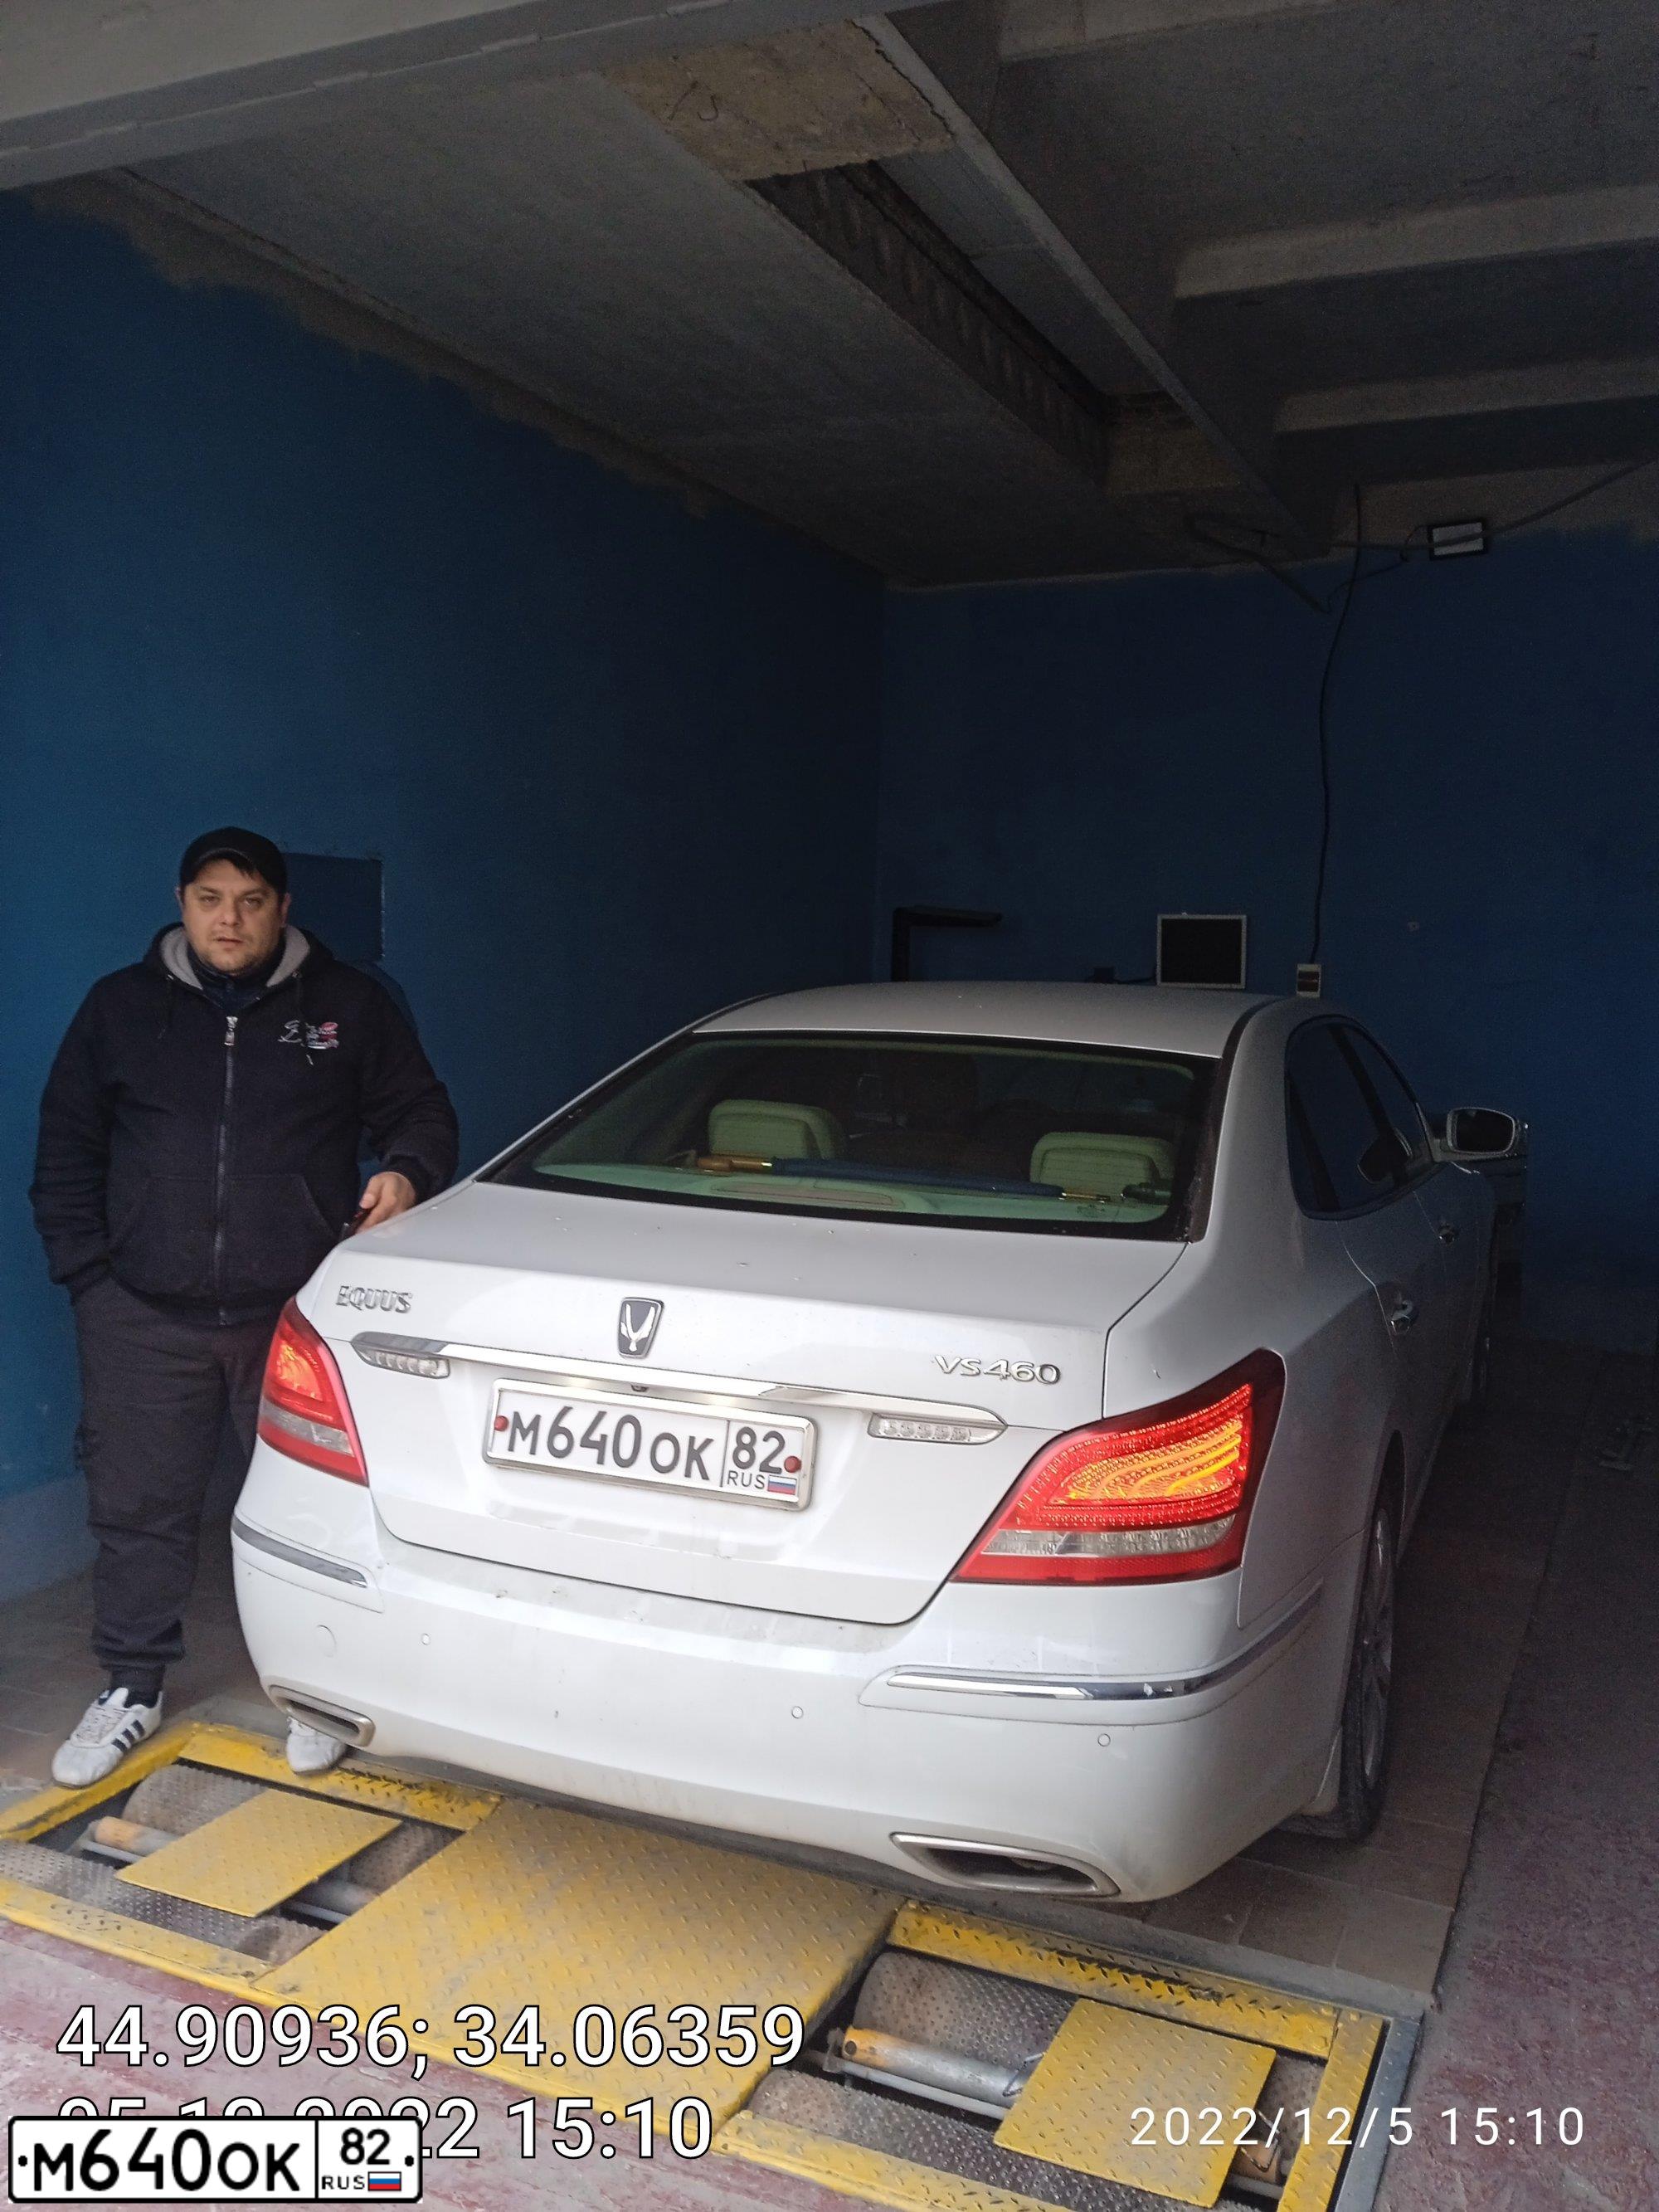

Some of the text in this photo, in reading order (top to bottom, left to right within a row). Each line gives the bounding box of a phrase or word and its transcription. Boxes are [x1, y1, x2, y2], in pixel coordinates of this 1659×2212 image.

[335, 1284, 412, 1314] EQUUS
[934, 1354, 1062, 1385] VS460
[732, 1425, 786, 1475] 82
[727, 1469, 766, 1491] RUS
